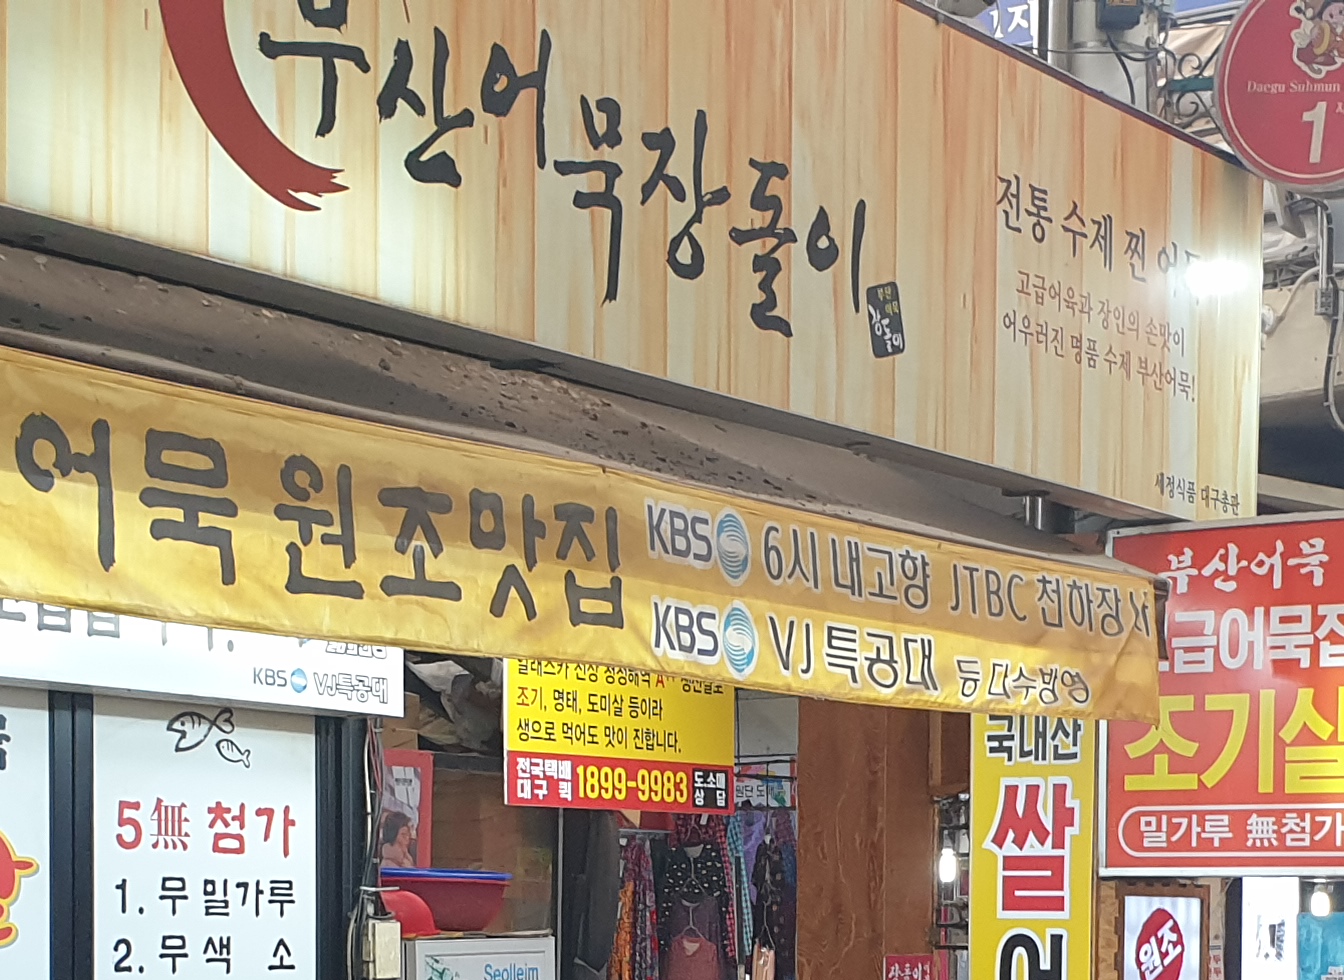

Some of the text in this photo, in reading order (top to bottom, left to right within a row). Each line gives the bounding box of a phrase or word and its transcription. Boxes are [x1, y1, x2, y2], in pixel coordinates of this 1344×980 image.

[1247, 80, 1286, 94] Daegu
[1301, 101, 1328, 164] 1
[996, 174, 1053, 243] 전통
[1060, 200, 1114, 272] 수제
[1124, 227, 1147, 283] 찐
[1016, 269, 1185, 357] 고급어육과 장인의 손맛이
[1003, 309, 1196, 403] 어우러진 명품 수제 부산어묵!
[13, 411, 239, 587] 어묵
[273, 453, 624, 629] 원조맛집
[646, 506, 712, 563] KBS
[764, 524, 820, 591] 6시
[829, 536, 930, 609] 내고향
[950, 563, 1027, 623] JTBC
[1157, 537, 1330, 595] 부산어묵
[654, 604, 718, 657] KBS
[253, 666, 288, 687] KBS
[587, 693, 624, 717] 도미살
[628, 698, 663, 721] 등이라
[516, 717, 682, 753] 생으로 먹어도 맛이 진합니다.
[986, 715, 1081, 763] 국내산
[516, 757, 572, 780] 전국택배
[516, 779, 548, 799] 대구
[576, 765, 688, 803] 1899-9983
[207, 801, 297, 859] 첨가
[1139, 814, 1233, 848] 밀가루
[158, 876, 190, 918] 무
[202, 876, 297, 918] 밀가루
[158, 933, 190, 975] 무
